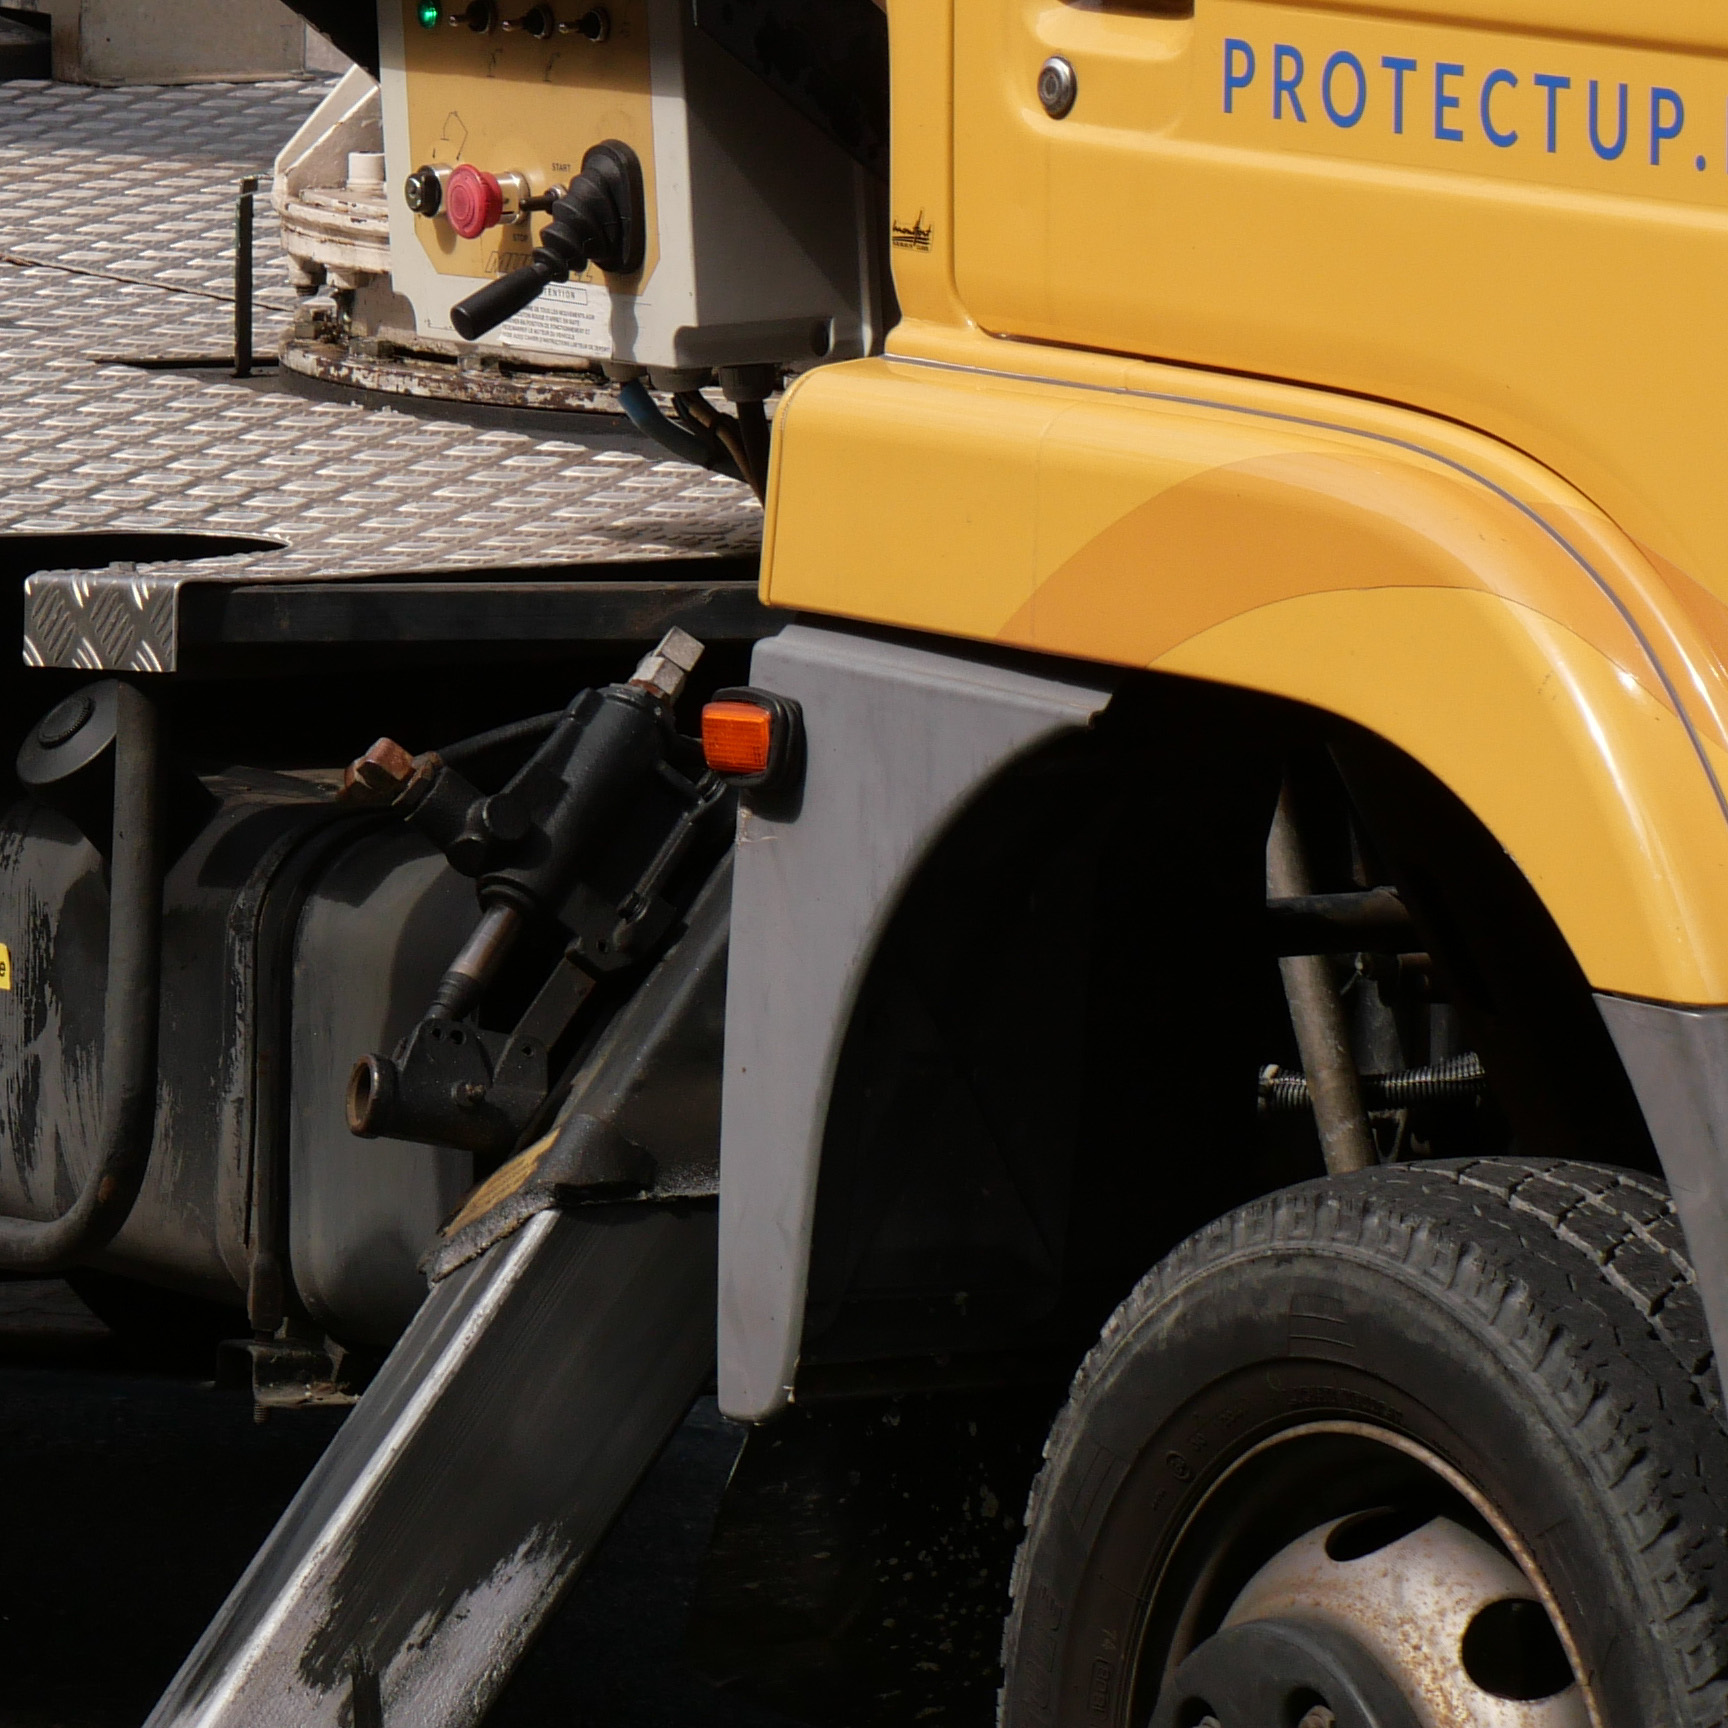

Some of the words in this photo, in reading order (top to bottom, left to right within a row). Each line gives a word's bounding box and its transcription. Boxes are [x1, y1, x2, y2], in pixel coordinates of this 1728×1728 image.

[1223, 38, 1728, 175] PROTECTUP.
[552, 162, 571, 173] START
[512, 233, 529, 243] STOP
[543, 288, 575, 298] TENTION
